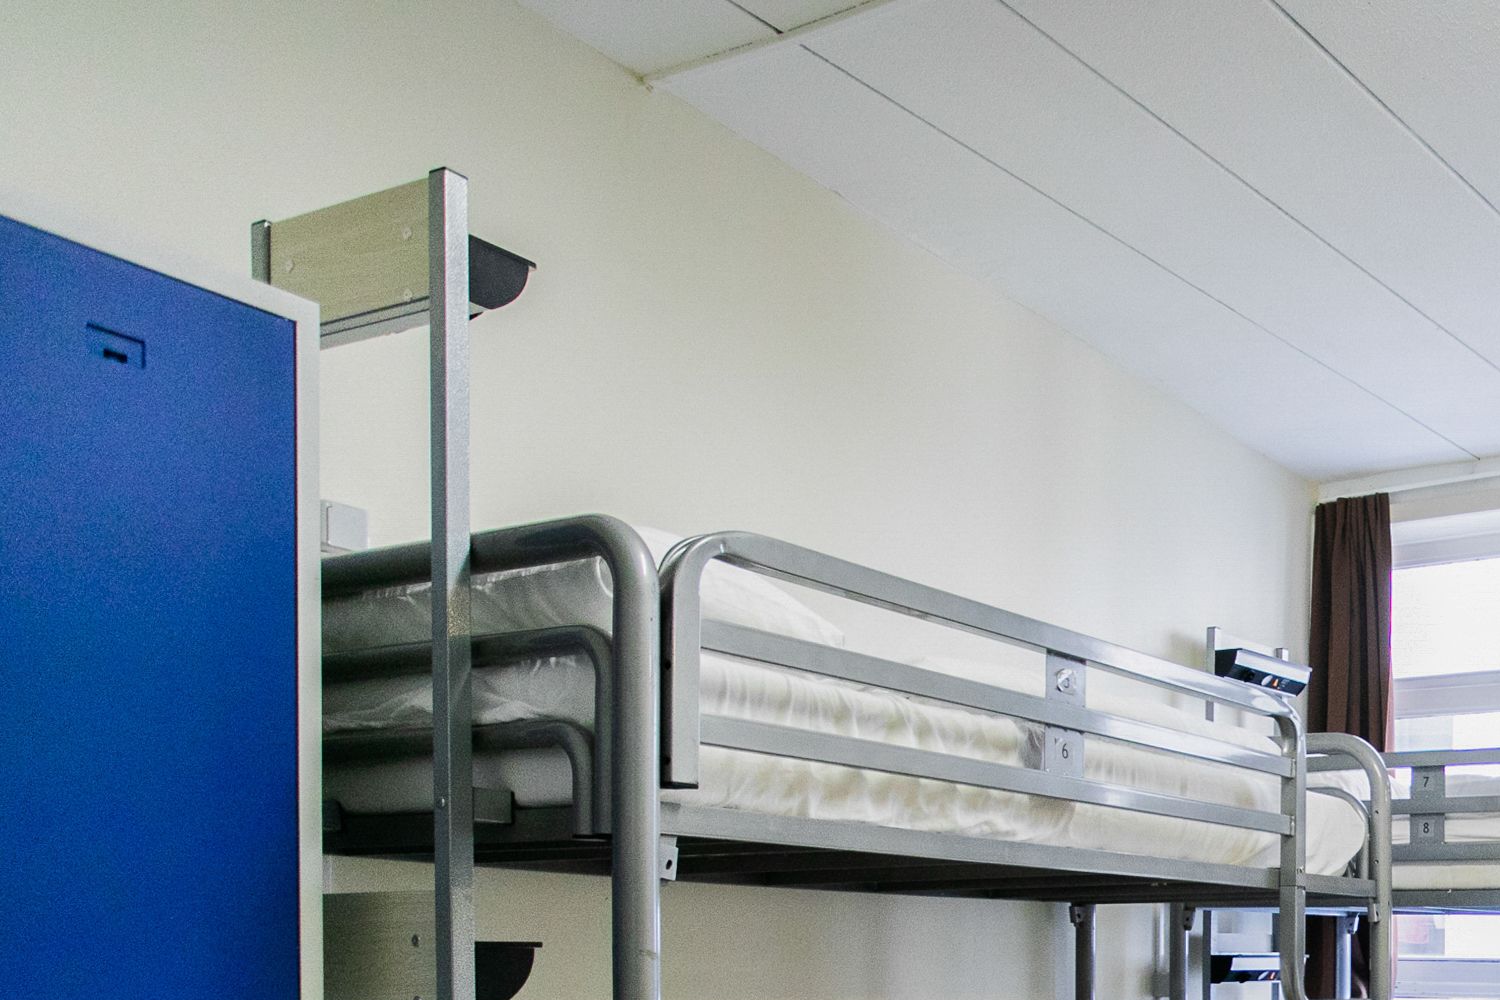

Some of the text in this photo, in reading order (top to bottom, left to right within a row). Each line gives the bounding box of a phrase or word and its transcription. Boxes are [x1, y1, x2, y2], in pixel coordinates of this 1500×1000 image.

[1061, 742, 1069, 759] 6
[1423, 776, 1430, 788] 7
[1422, 822, 1430, 834] 8
